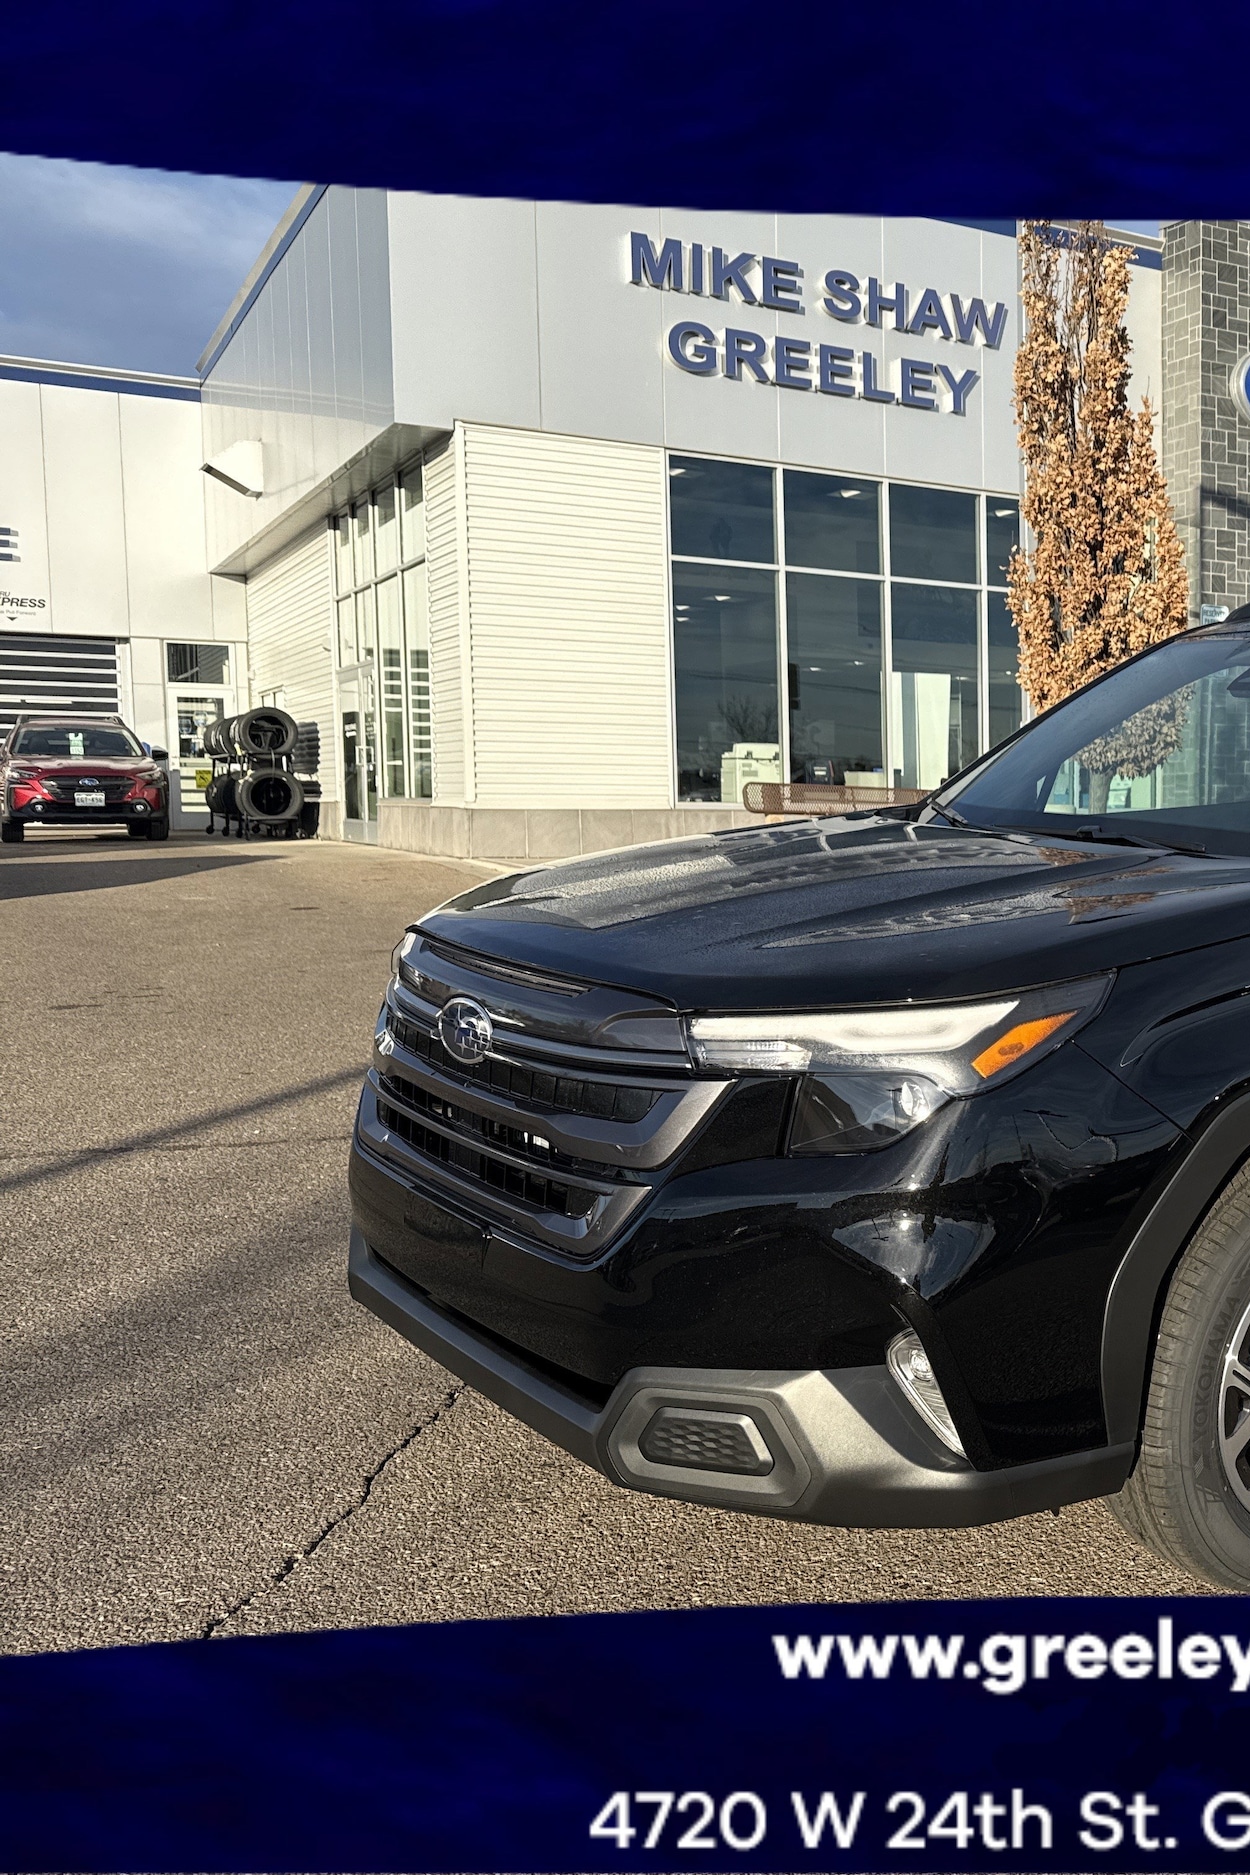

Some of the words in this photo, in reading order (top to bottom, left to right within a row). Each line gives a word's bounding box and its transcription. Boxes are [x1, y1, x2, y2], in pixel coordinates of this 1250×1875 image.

[630, 231, 804, 314] MIKE
[823, 269, 1007, 349] SHAW
[667, 320, 979, 415] GREELEY
[0, 597, 46, 608] PRESS
[1193, 1296, 1240, 1442] YOKOHAMA
